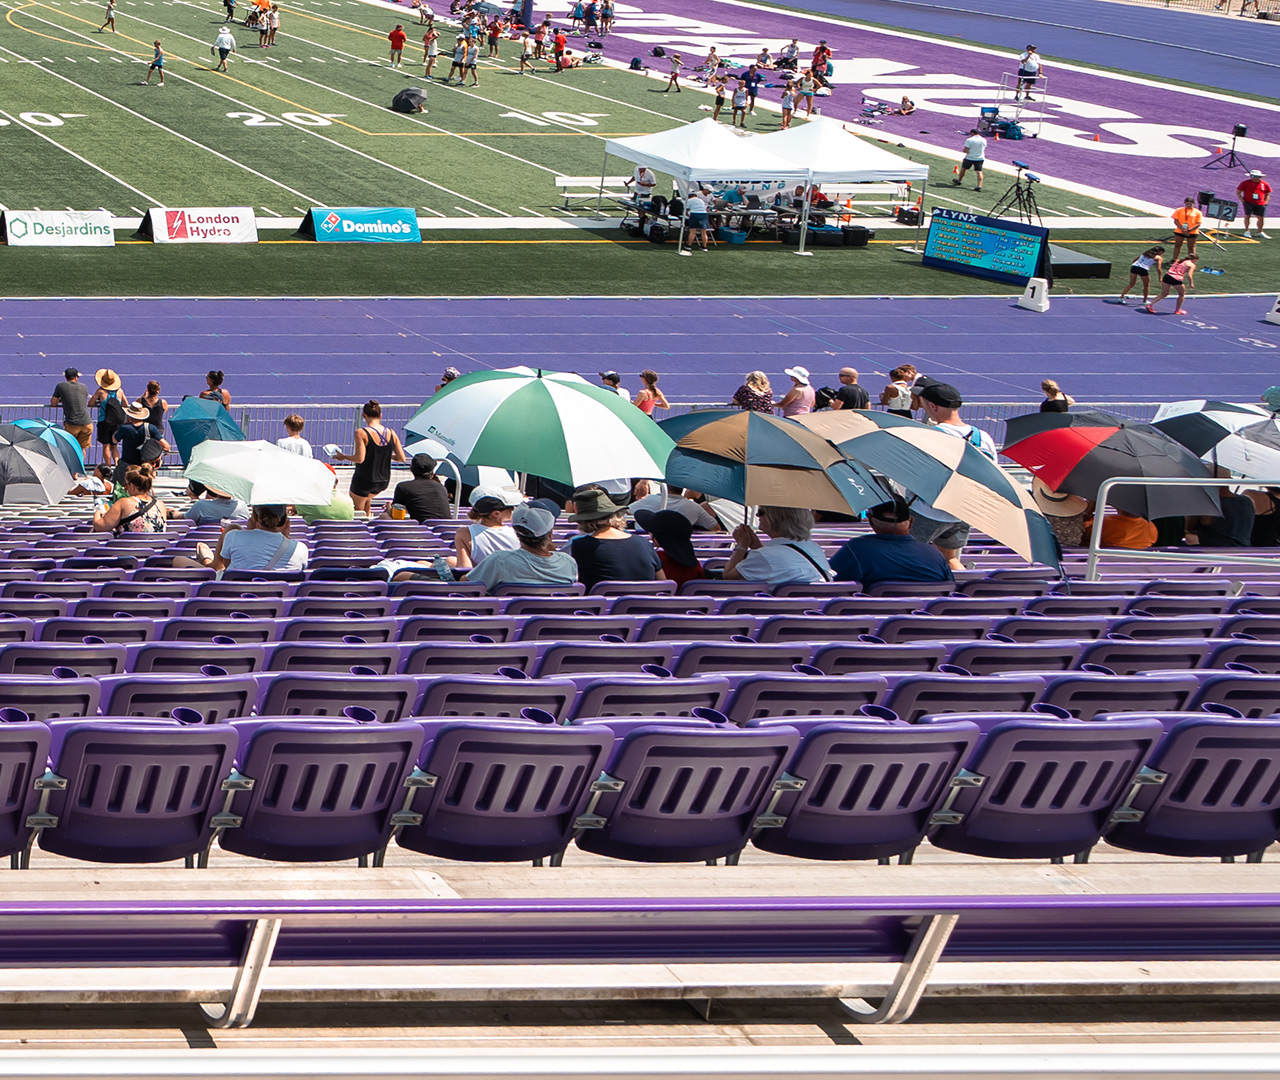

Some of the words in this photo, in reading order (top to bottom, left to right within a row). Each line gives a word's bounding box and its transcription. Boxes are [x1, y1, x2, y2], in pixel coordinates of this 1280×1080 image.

[226, 113, 333, 126] 20
[498, 113, 598, 125] 10
[188, 214, 240, 224] London
[942, 210, 979, 223] LYNX
[1222, 206, 1233, 219] 2
[33, 221, 111, 237] Desjardins
[190, 226, 231, 239] Hydro
[342, 219, 411, 234] Domino's
[1029, 285, 1036, 299] 1
[1237, 336, 1278, 349] 3
